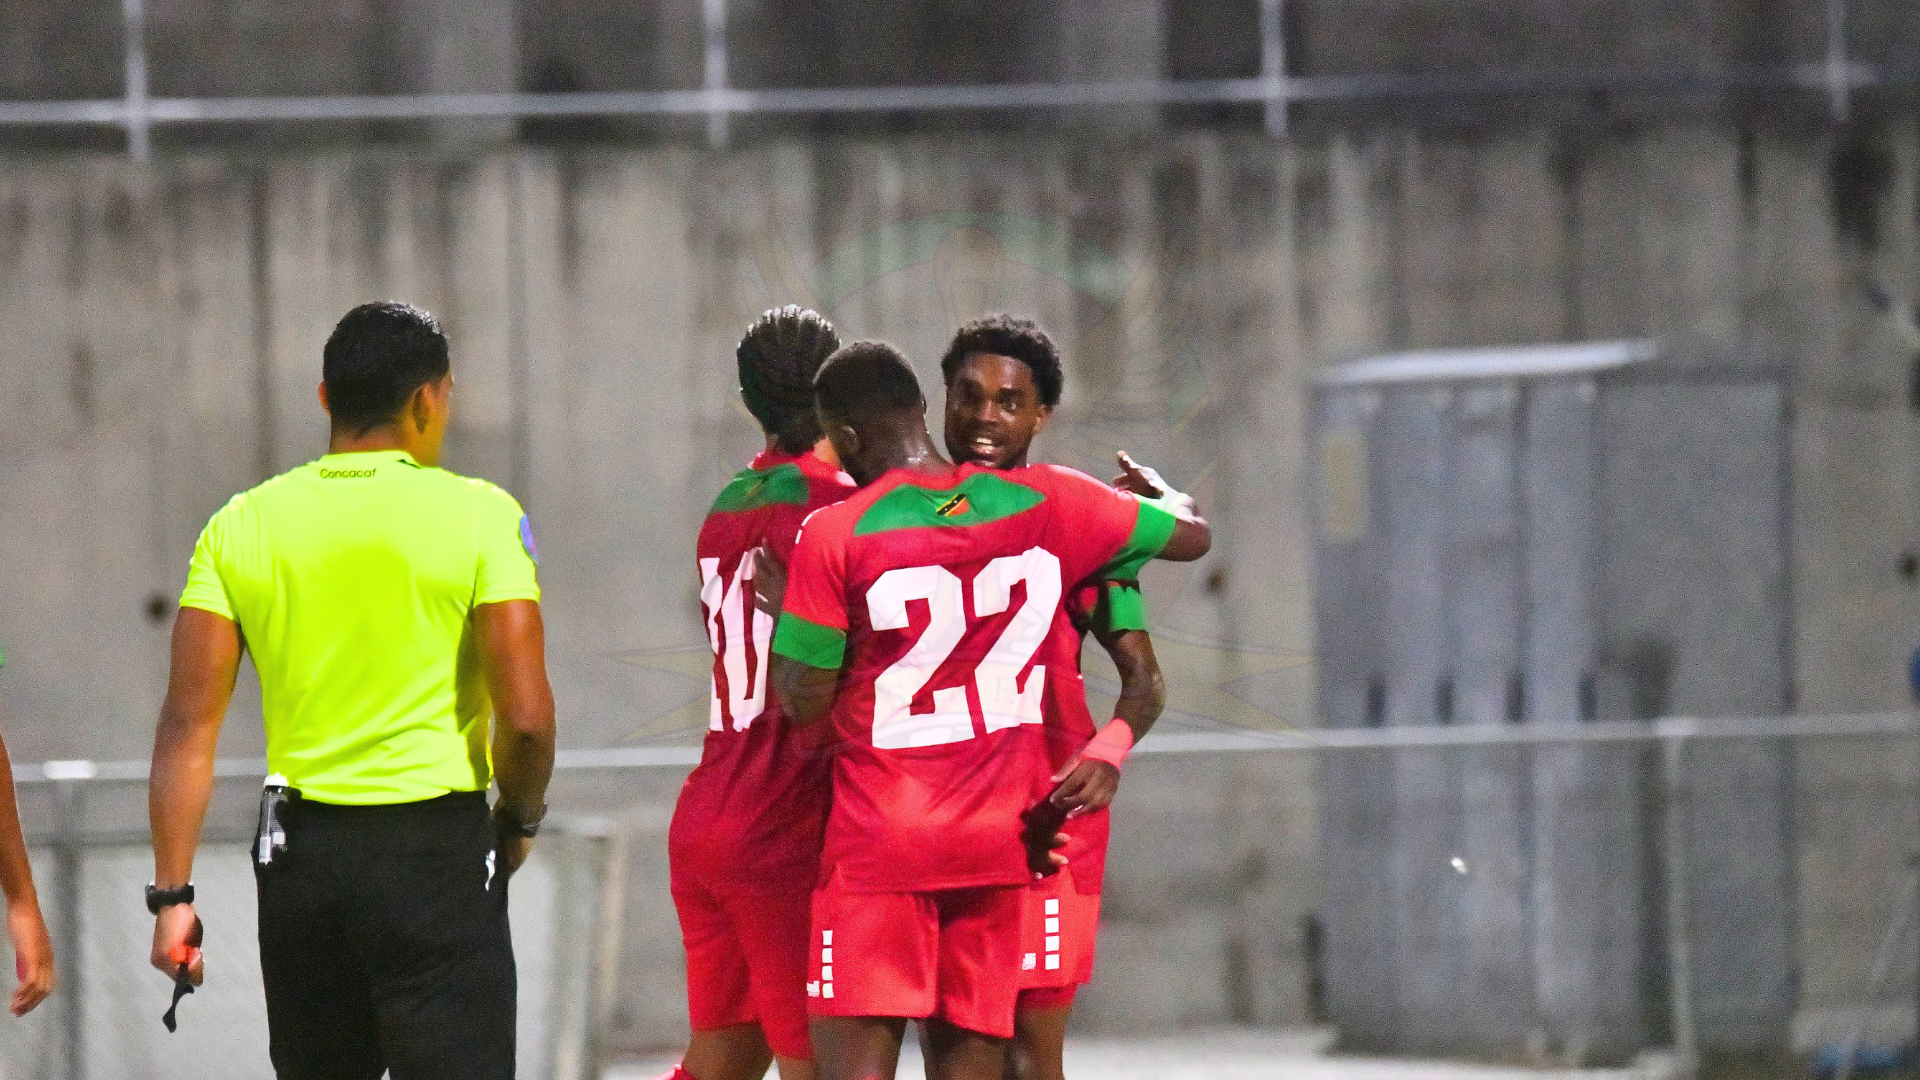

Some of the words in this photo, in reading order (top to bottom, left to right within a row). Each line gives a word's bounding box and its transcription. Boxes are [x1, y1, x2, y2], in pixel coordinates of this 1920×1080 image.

[320, 467, 377, 479] Concacaf
[700, 547, 774, 732] 10
[866, 545, 1062, 749] 22
